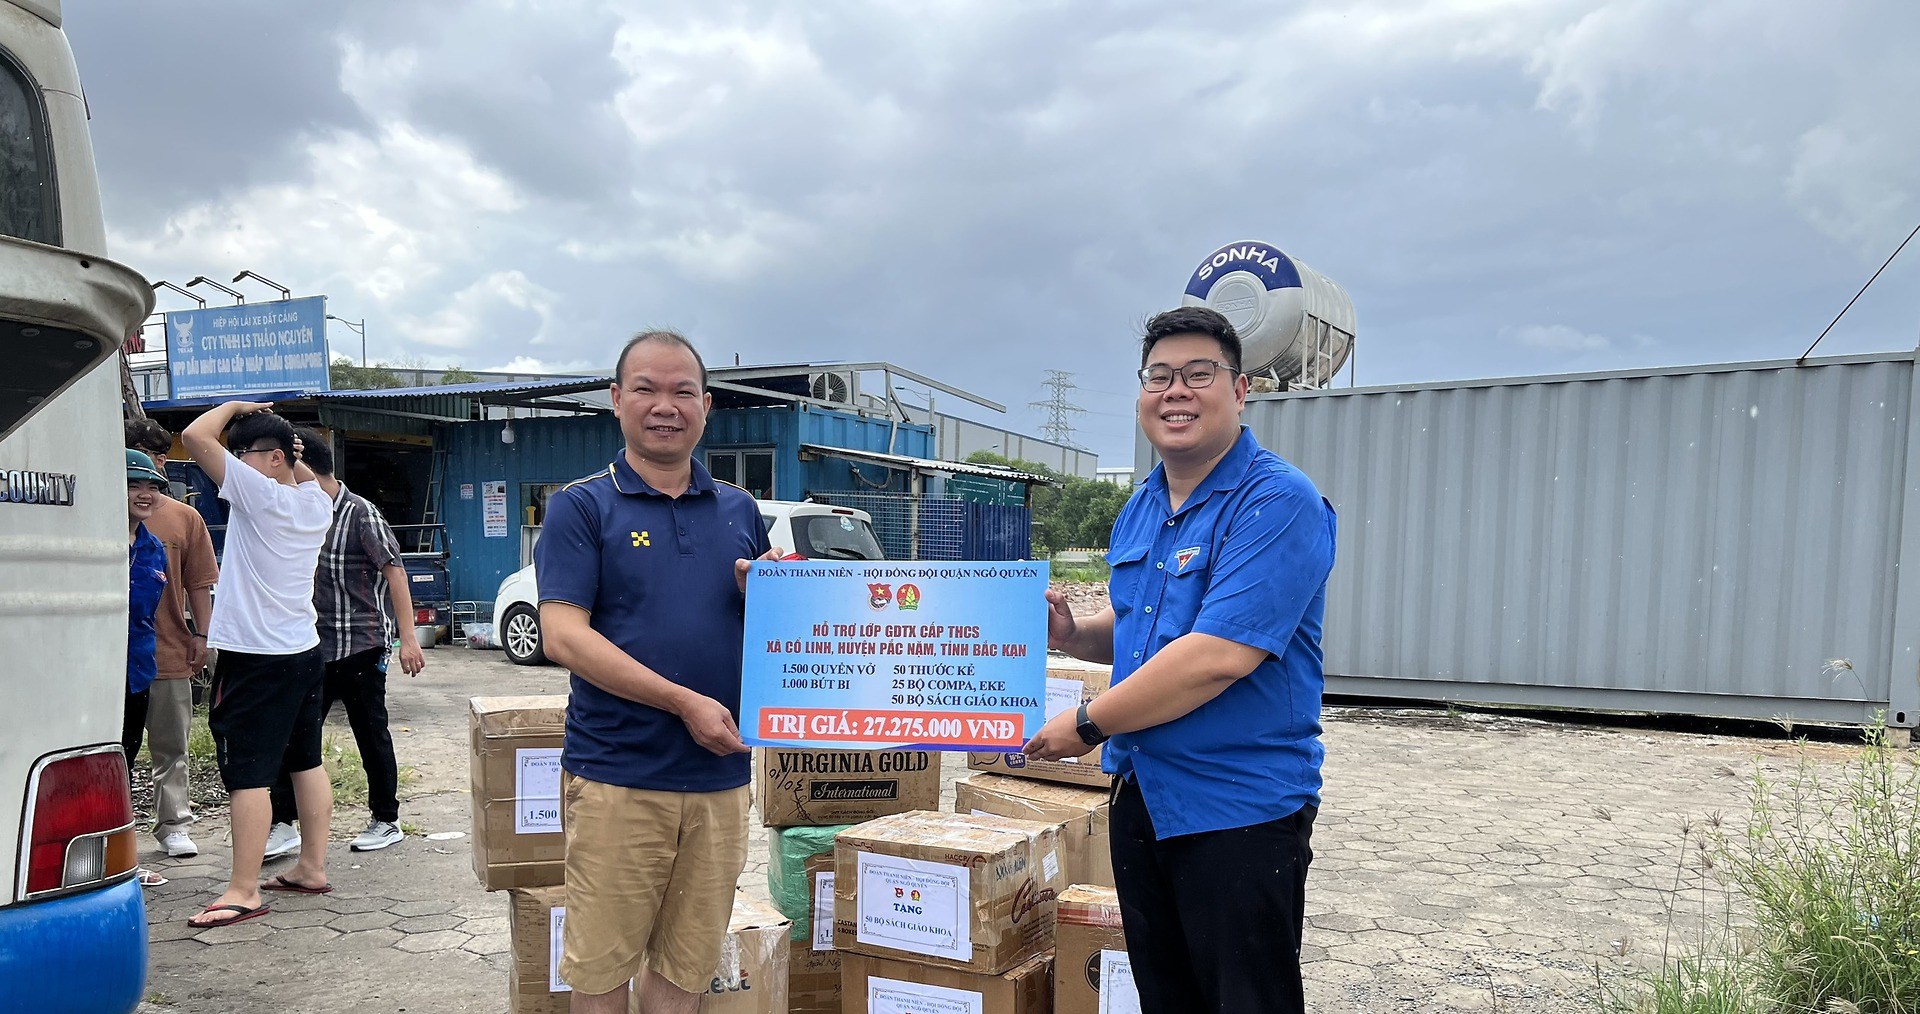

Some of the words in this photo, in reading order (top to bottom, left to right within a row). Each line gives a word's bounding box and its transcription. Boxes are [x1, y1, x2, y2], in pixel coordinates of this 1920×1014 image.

[1198, 246, 1279, 280] SONHA
[253, 315, 262, 325] XE
[202, 336, 218, 350] CTY
[0, 468, 76, 506] COUNTY
[758, 566, 788, 577] ĐOÀN
[790, 568, 826, 577] THANH
[828, 567, 853, 578] NIÊN
[864, 568, 882, 579] HỘI
[885, 567, 916, 578] ĐỒNG
[918, 568, 938, 579] ĐỘI
[940, 568, 970, 580] QUẬN
[974, 566, 998, 578] NGÔ
[833, 623, 857, 640] TRỢ
[860, 622, 882, 638] LỚP
[885, 624, 916, 638] GDTX
[920, 621, 944, 638] CẤP
[948, 626, 980, 638] THCS
[766, 638, 782, 653] XÃ
[805, 641, 834, 655] LINH,
[838, 640, 876, 657] HUYỆN
[879, 639, 904, 656] PẮC
[908, 641, 937, 658] NẶM,
[940, 640, 969, 656] TỈNH
[973, 640, 998, 657] BẮC
[1002, 644, 1027, 659] KẠN
[782, 664, 808, 674] 1.500
[857, 662, 876, 675] VỞ
[893, 664, 906, 675] 50
[908, 662, 954, 676] THƯỚC
[782, 678, 808, 689] 1.000
[810, 677, 836, 689] BÚT
[838, 680, 850, 690] BI
[892, 679, 905, 689] 25
[907, 678, 925, 692] BỘ
[928, 680, 977, 692] COMPA,
[980, 681, 1006, 692] EKE
[891, 694, 904, 705] 50
[906, 694, 924, 707] BỘ
[926, 692, 962, 706] SÁCH
[964, 694, 998, 707] GIÁO
[1000, 696, 1038, 708] KHOA
[768, 714, 806, 739] TRỊ
[810, 710, 858, 736] GIÁ:
[863, 716, 962, 738] 27.275.000
[966, 719, 1016, 740] VNĐ
[778, 752, 874, 774] VIRGINIA
[878, 751, 929, 772] GOLD
[814, 782, 893, 799] International
[530, 810, 558, 820] 1.500
[865, 915, 872, 923] 50
[874, 916, 885, 926] BỘ
[886, 917, 906, 929] SÁCH
[907, 920, 928, 933] GIÁO
[928, 926, 952, 937] KHOA
